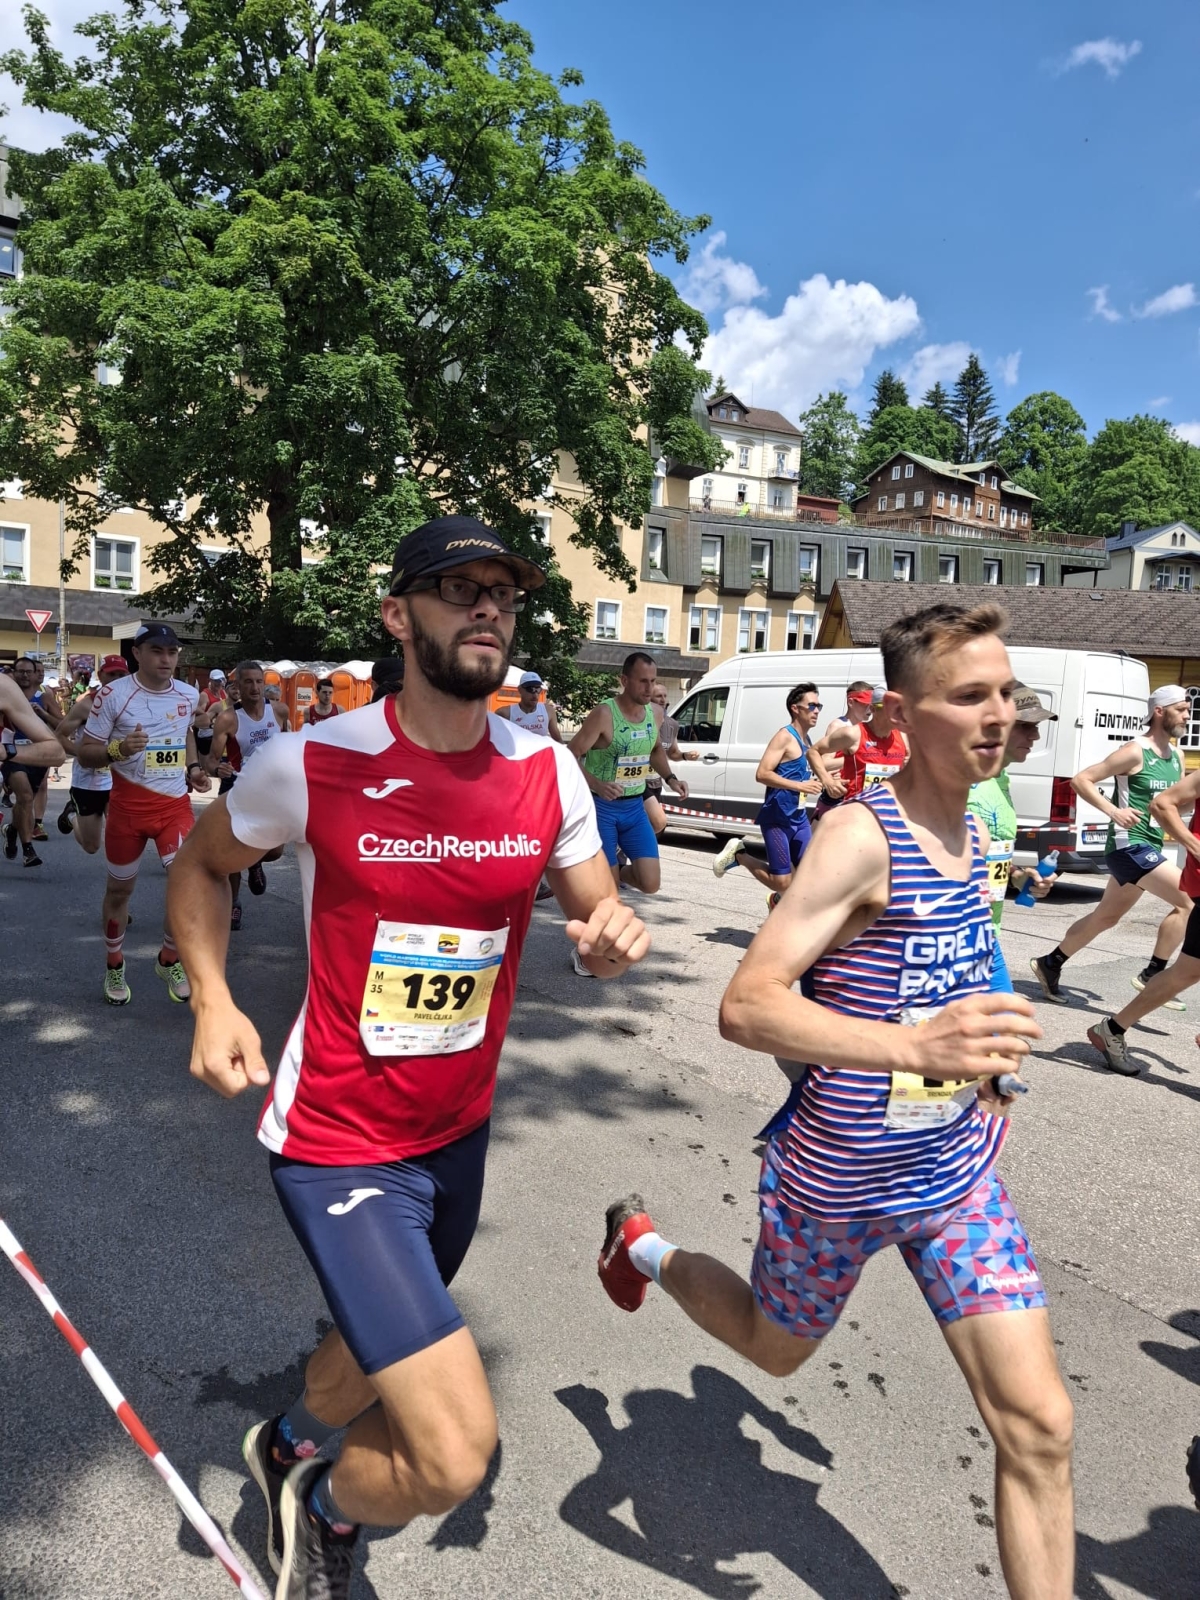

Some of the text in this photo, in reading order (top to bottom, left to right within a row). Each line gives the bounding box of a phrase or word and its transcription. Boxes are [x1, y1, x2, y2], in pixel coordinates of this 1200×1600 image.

[156, 751, 178, 763] 861
[624, 766, 642, 777] 285
[1150, 779, 1178, 790] IRELA
[904, 925, 995, 964] GREAT
[375, 970, 384, 980] M
[370, 984, 383, 994] 35
[403, 973, 476, 1011] 139
[414, 1012, 452, 1021] PAVEL ČEJKA
